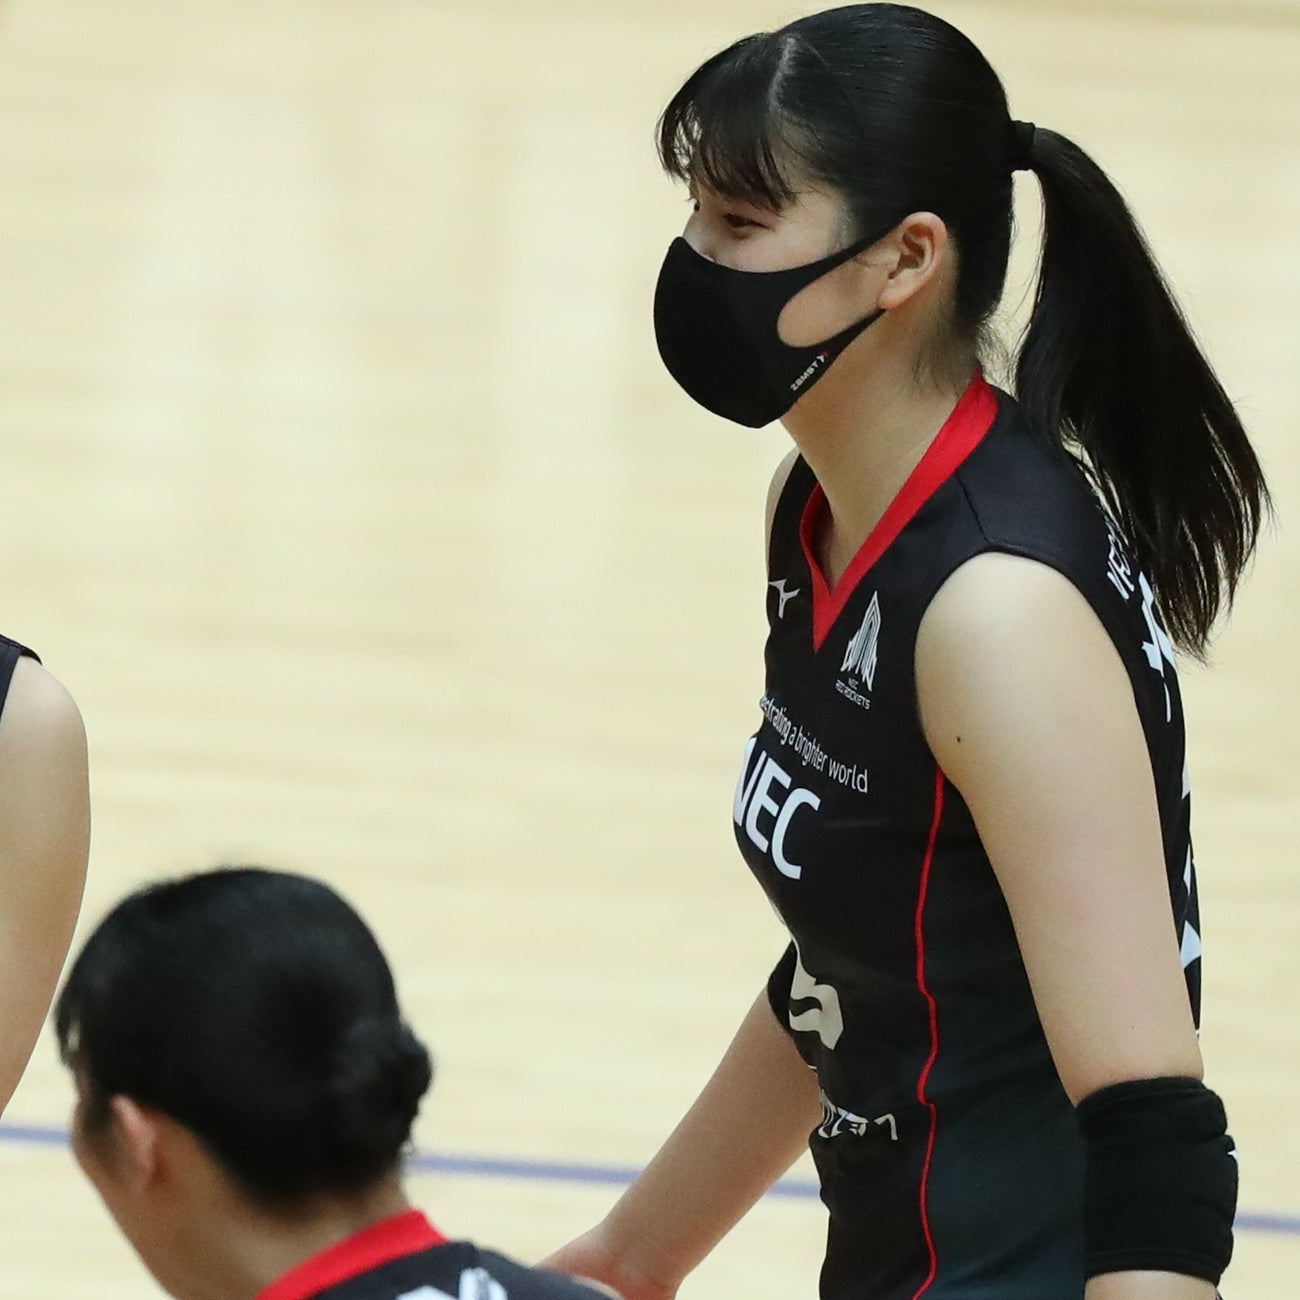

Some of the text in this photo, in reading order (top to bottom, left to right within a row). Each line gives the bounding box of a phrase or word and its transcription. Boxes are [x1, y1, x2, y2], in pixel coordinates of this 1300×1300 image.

[733, 737, 821, 880] NEC
[788, 726, 797, 746] a
[794, 725, 828, 772] brighter
[828, 758, 869, 793] world
